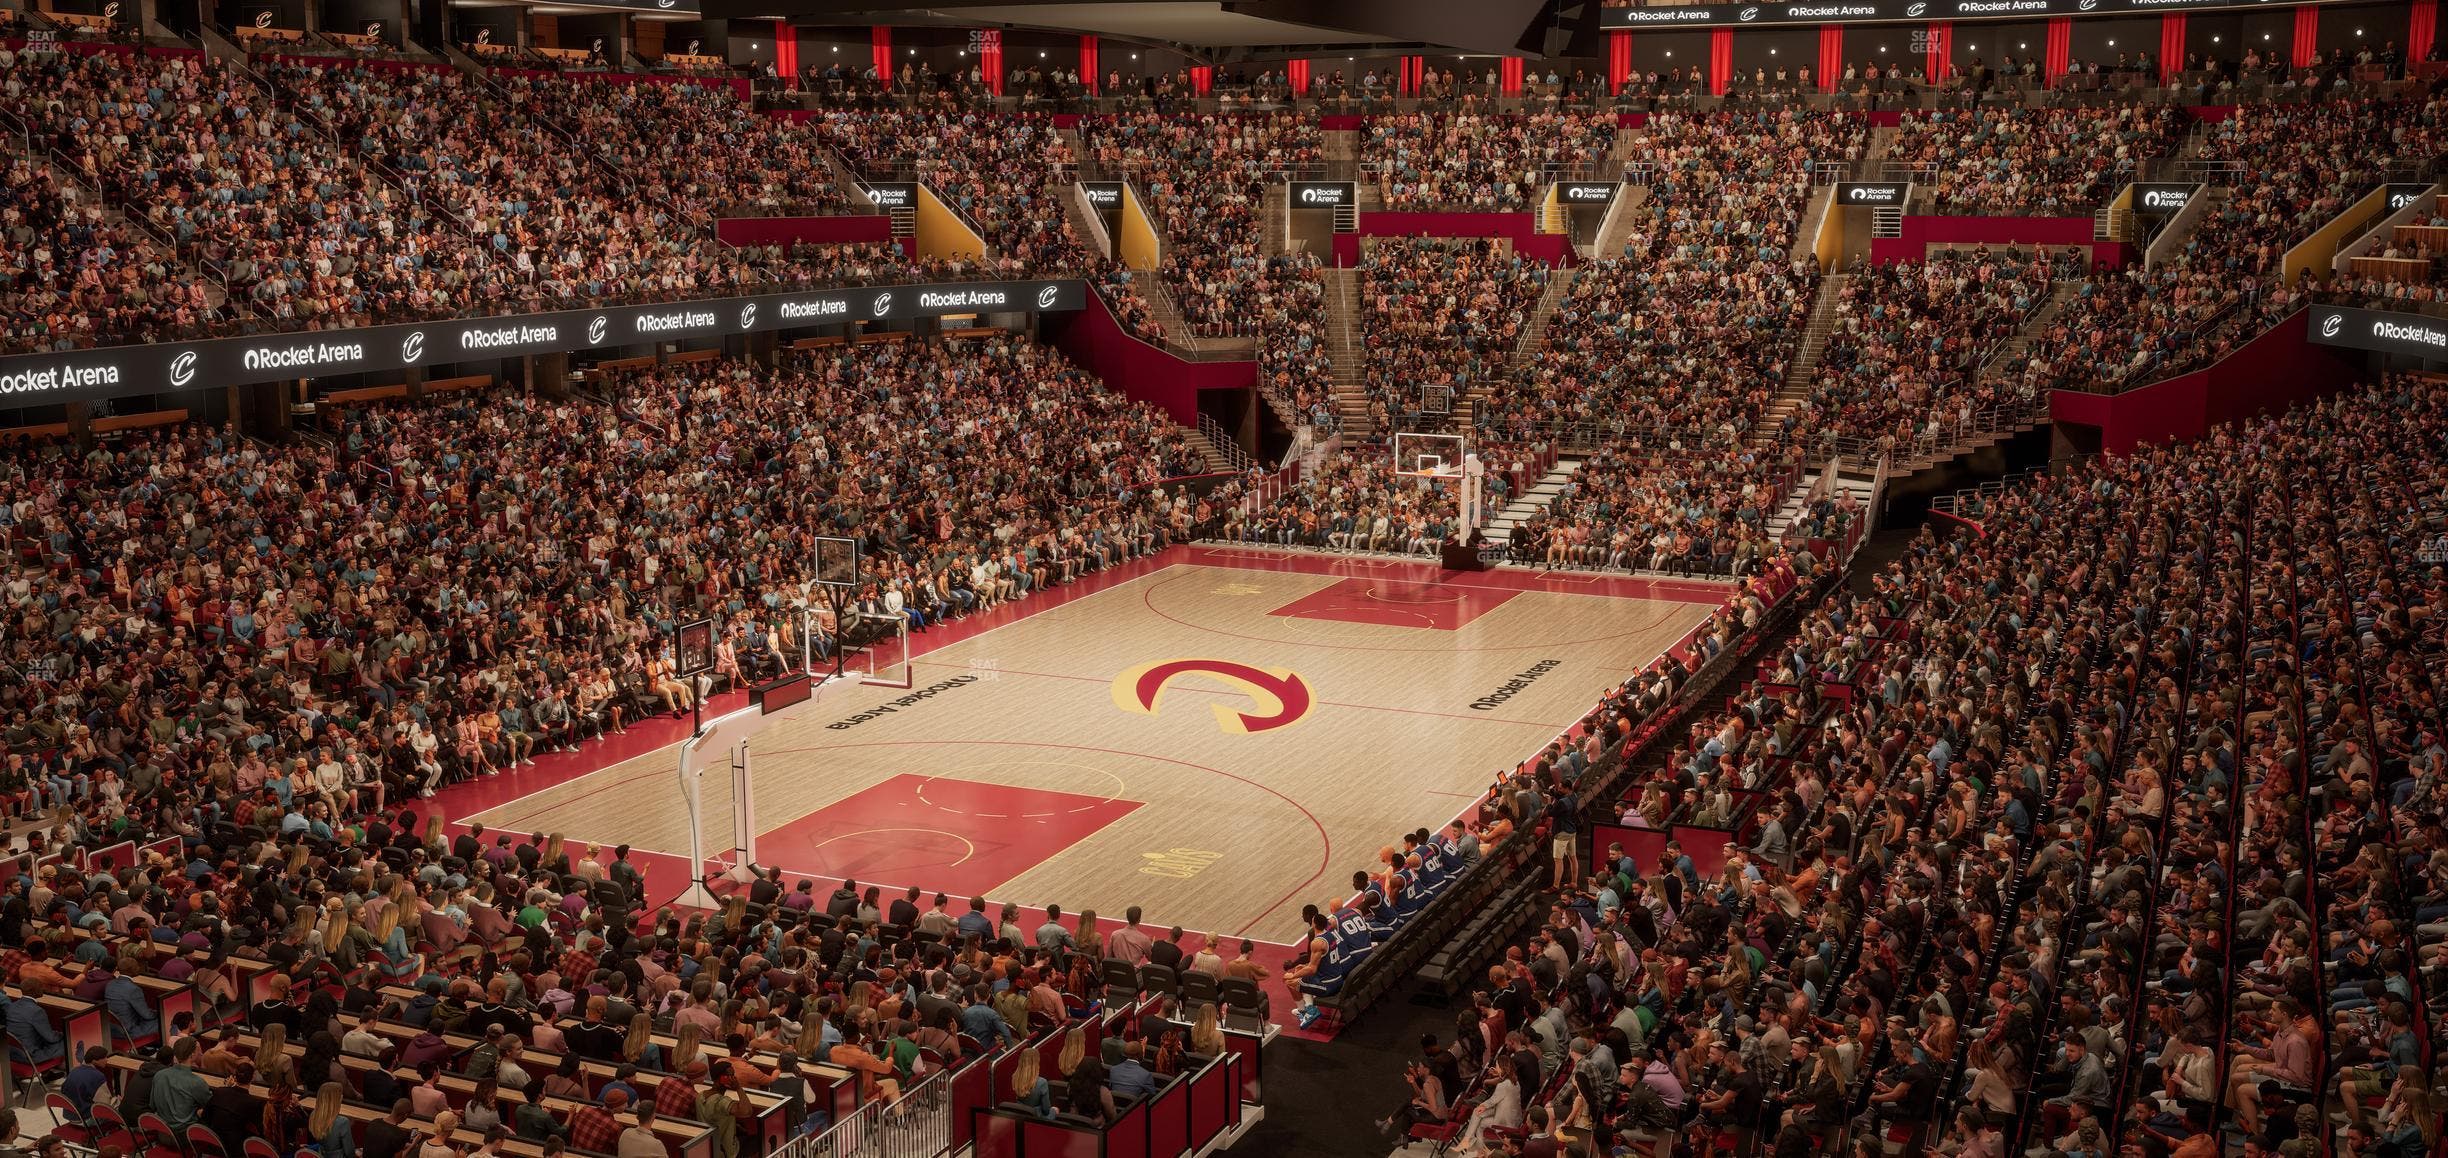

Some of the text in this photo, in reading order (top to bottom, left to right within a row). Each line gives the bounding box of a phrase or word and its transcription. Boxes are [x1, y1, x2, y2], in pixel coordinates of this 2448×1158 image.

[1638, 10, 1709, 21] Rocket Arena
[1800, 6, 1875, 16] Rocket Arena
[1971, 0, 2047, 12] Rocket Arena
[881, 189, 906, 197] Rocket
[1316, 188, 1342, 196] Rocket
[930, 290, 1005, 307] Rocket Arena
[789, 300, 846, 317] Rocket Arena
[647, 311, 715, 331] Rocket Arena
[474, 325, 557, 348] Rocket Arena
[2385, 322, 2446, 347] Rocket Arena
[260, 343, 363, 369] Rocket Arena
[62, 364, 119, 388] Arena
[1476, 660, 1562, 704] Rocket Arena
[825, 678, 967, 730] Rocket Arena
[1342, 916, 1367, 935] 00
